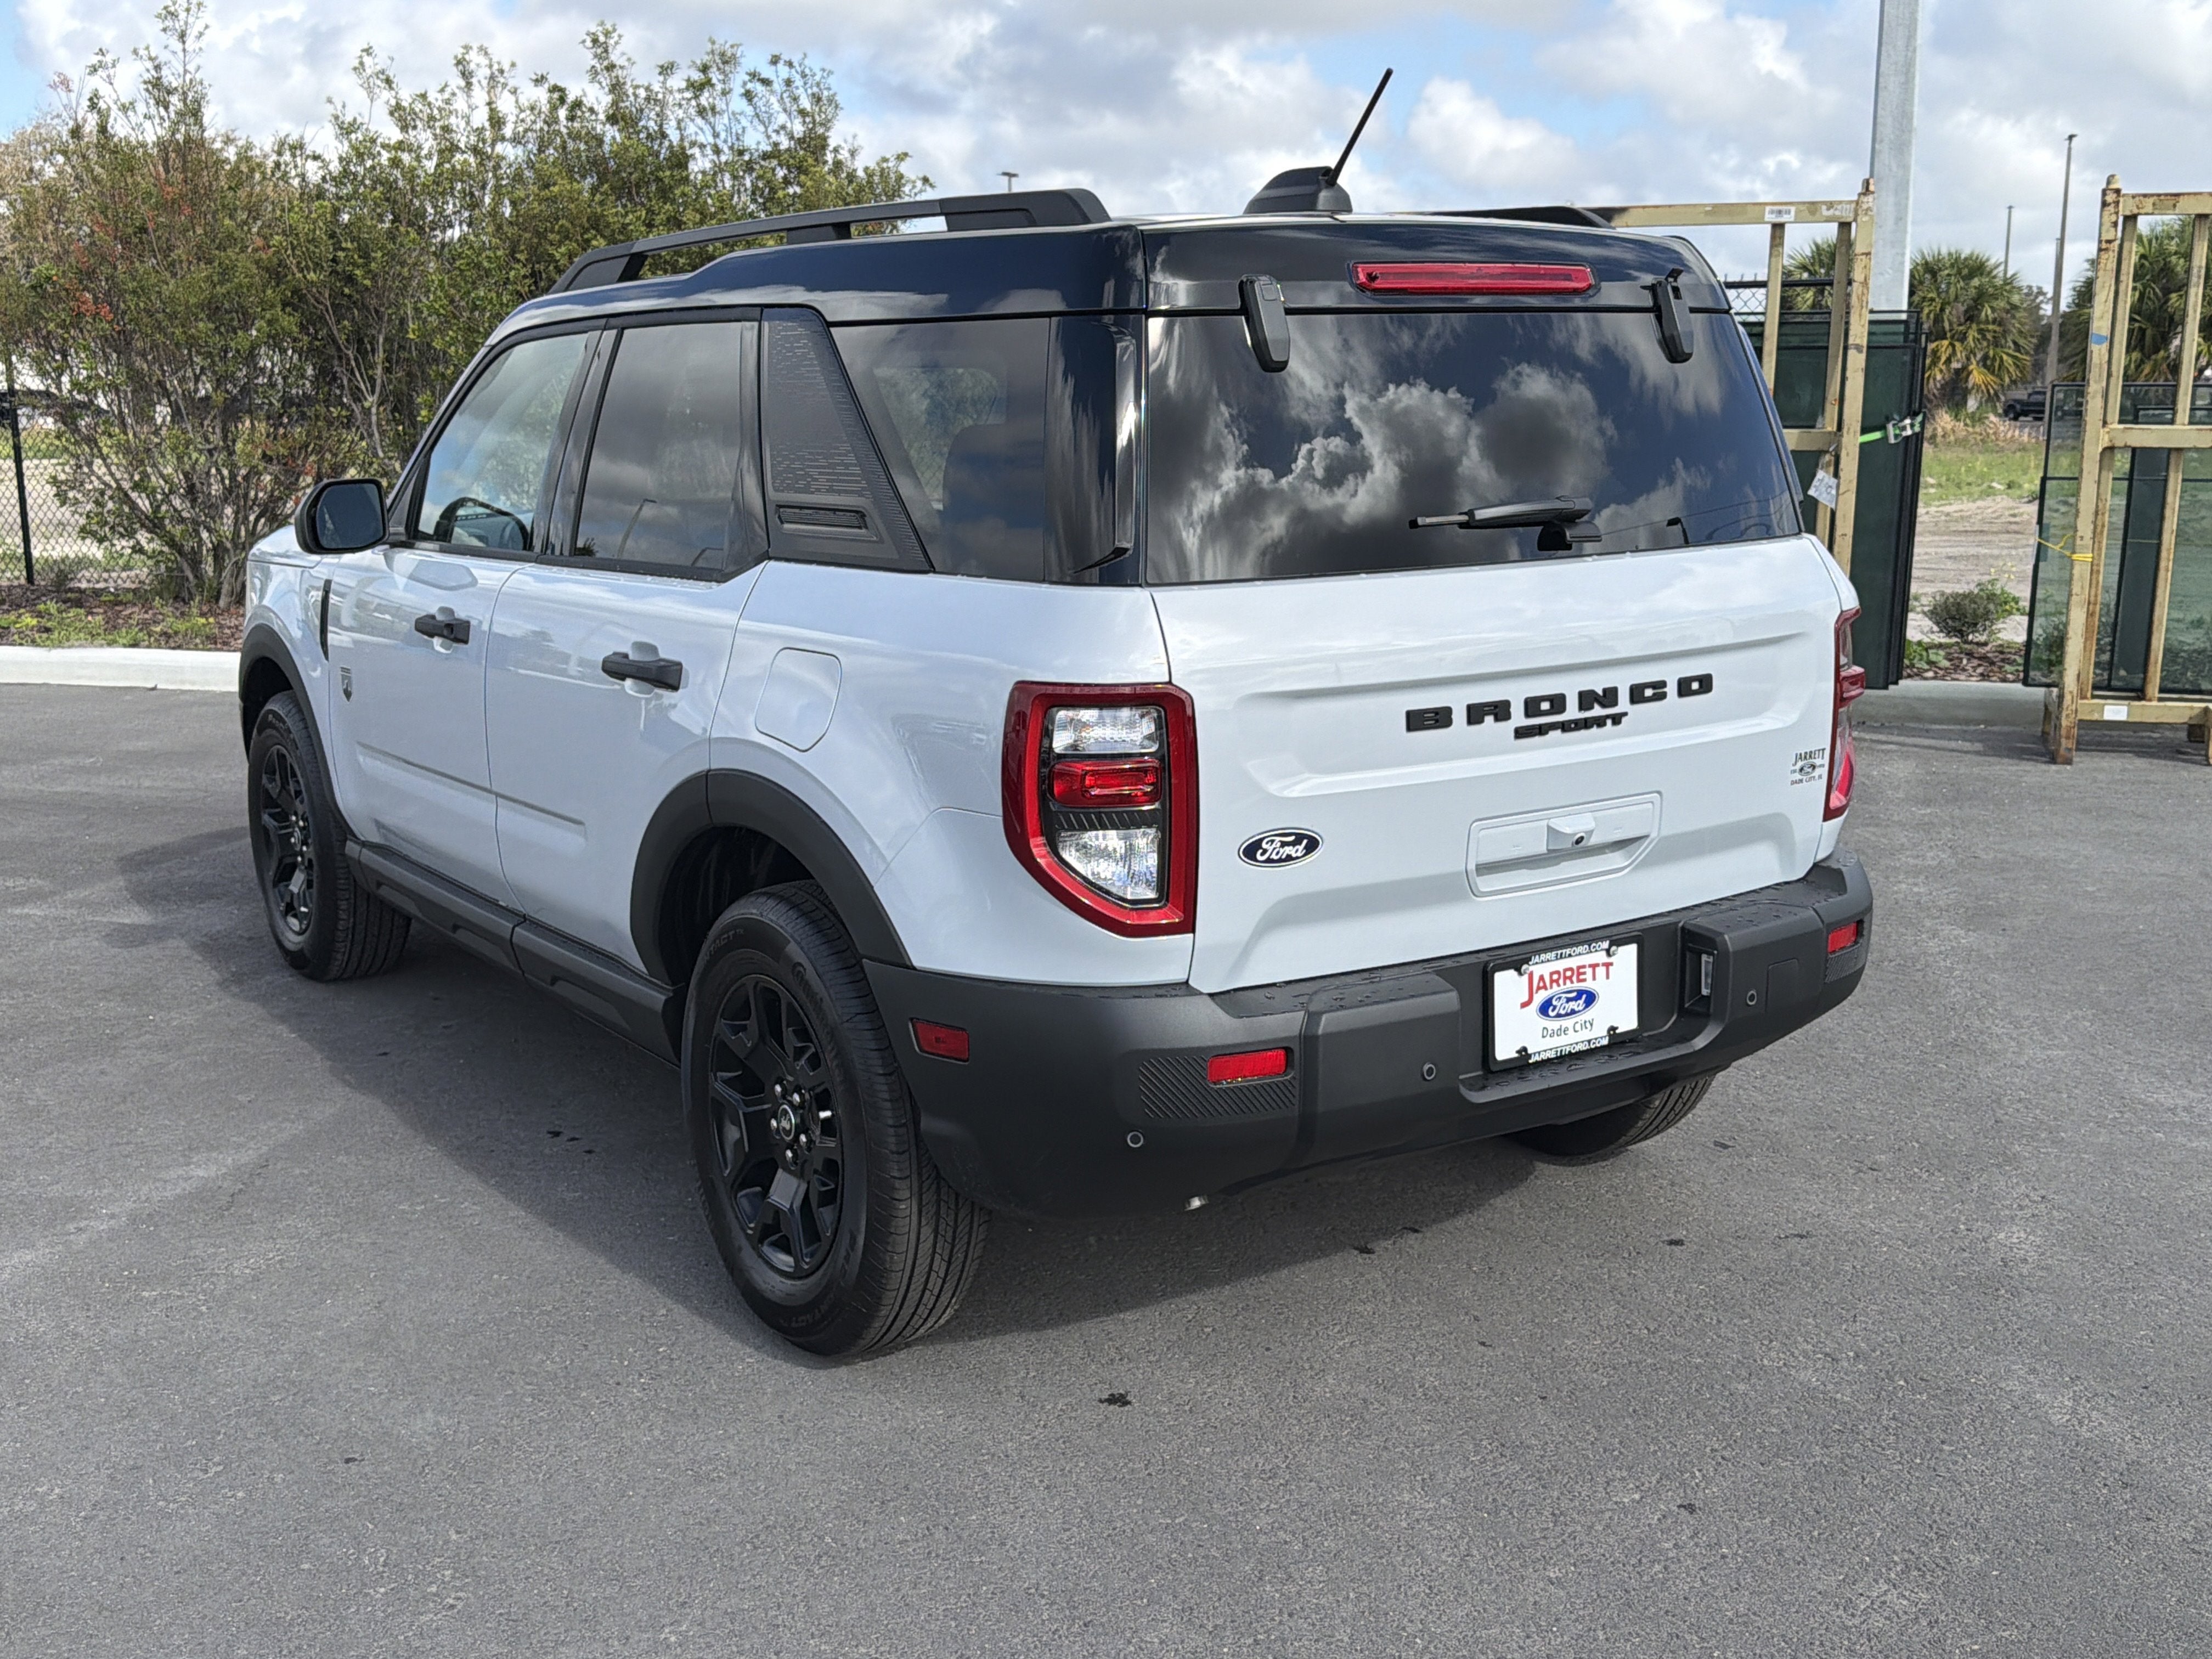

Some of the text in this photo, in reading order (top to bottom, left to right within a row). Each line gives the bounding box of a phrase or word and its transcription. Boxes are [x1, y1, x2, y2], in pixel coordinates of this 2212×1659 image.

[1405, 673, 1713, 732] BRONCO
[1513, 712, 1629, 740] SPORT
[1792, 747, 1826, 766] JARRETT
[1256, 836, 1308, 861] Ford
[1528, 940, 1610, 965] JARRETTFORD.COM
[1520, 962, 1614, 1009] JARRETT
[1548, 991, 1587, 1017] Ford
[1541, 1018, 1594, 1039] Dade City
[1528, 1036, 1609, 1063] JARRETTFORD.COM
